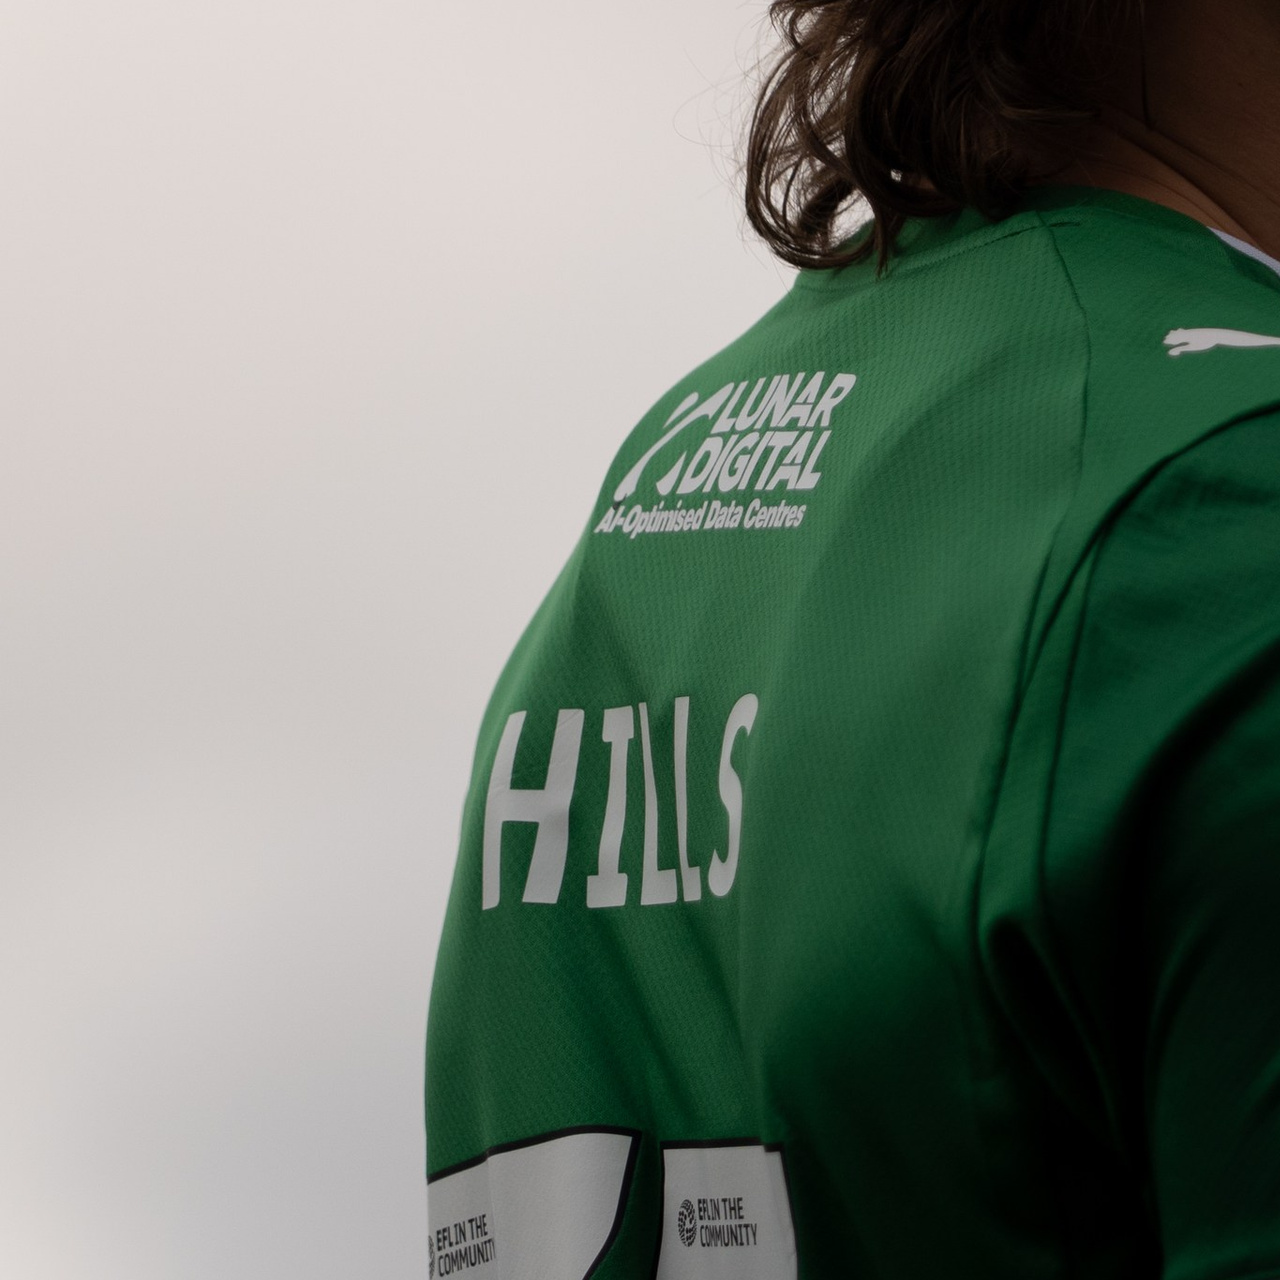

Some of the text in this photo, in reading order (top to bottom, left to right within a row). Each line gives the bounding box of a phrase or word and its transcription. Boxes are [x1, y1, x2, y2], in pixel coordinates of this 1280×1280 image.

[711, 370, 857, 435] LUNAR
[676, 429, 832, 495] DIGITAL
[594, 498, 807, 539] AI-Optimised Data Centres
[481, 692, 759, 911] HILLS
[721, 1197, 744, 1220] THE
[436, 1213, 488, 1252] EFL IN THE
[699, 1223, 758, 1248] COMMUNITY
